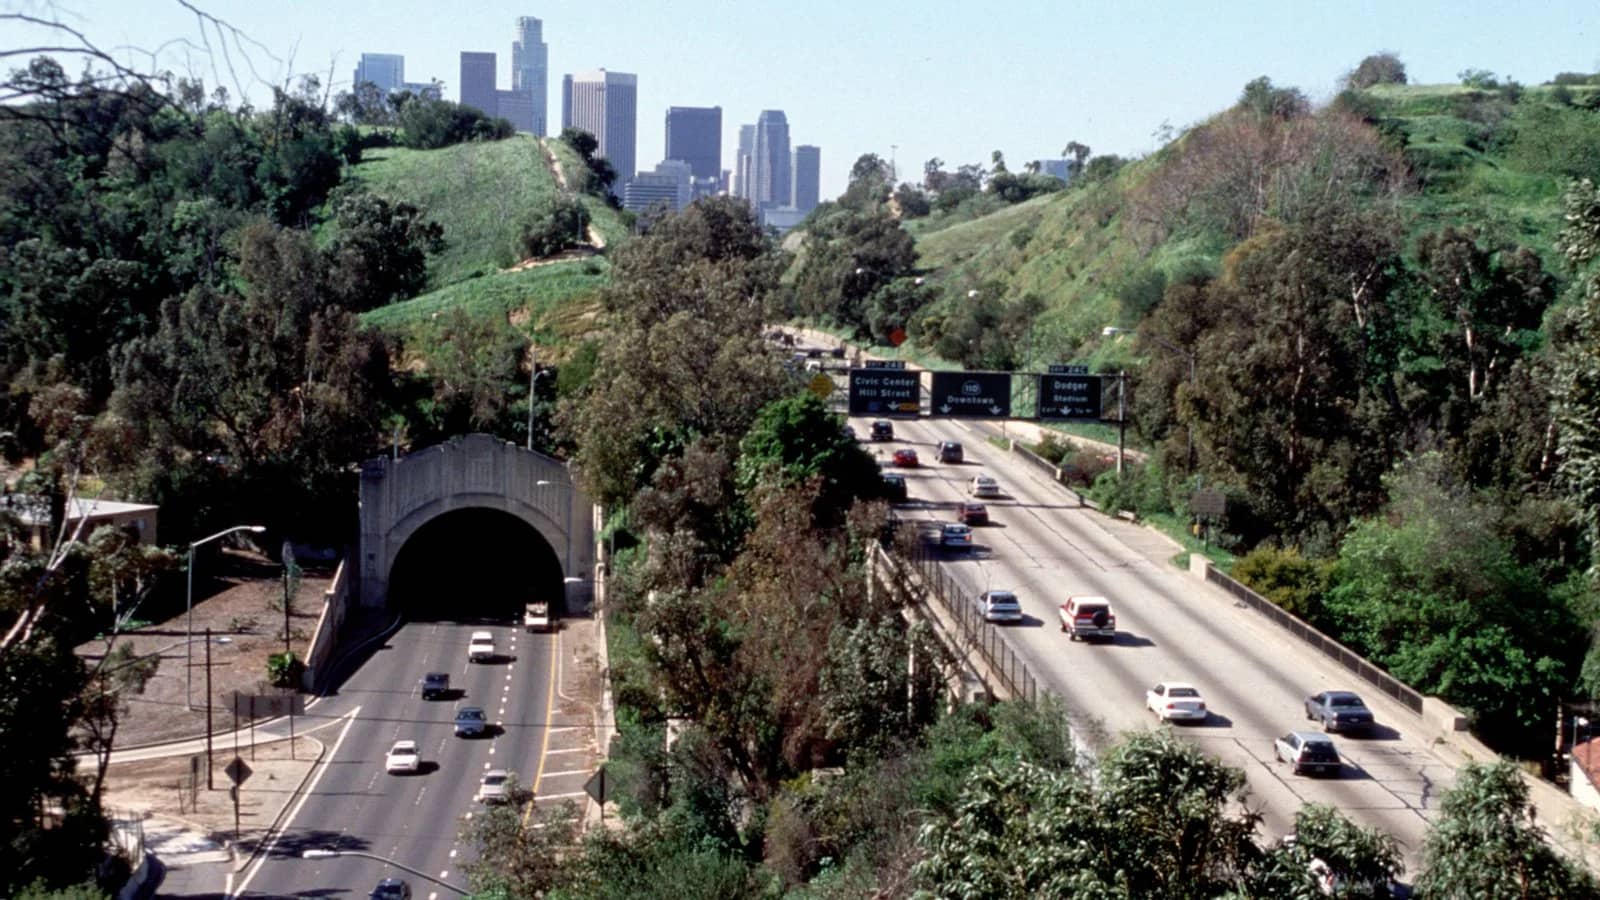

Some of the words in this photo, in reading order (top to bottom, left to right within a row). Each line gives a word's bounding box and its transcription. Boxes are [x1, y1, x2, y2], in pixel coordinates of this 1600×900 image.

[855, 377, 879, 385] Civic
[882, 377, 915, 386] Center
[1054, 381, 1088, 391] Dodger
[859, 389, 877, 397] Hill
[880, 389, 911, 398] Street
[947, 395, 994, 404] Downtown
